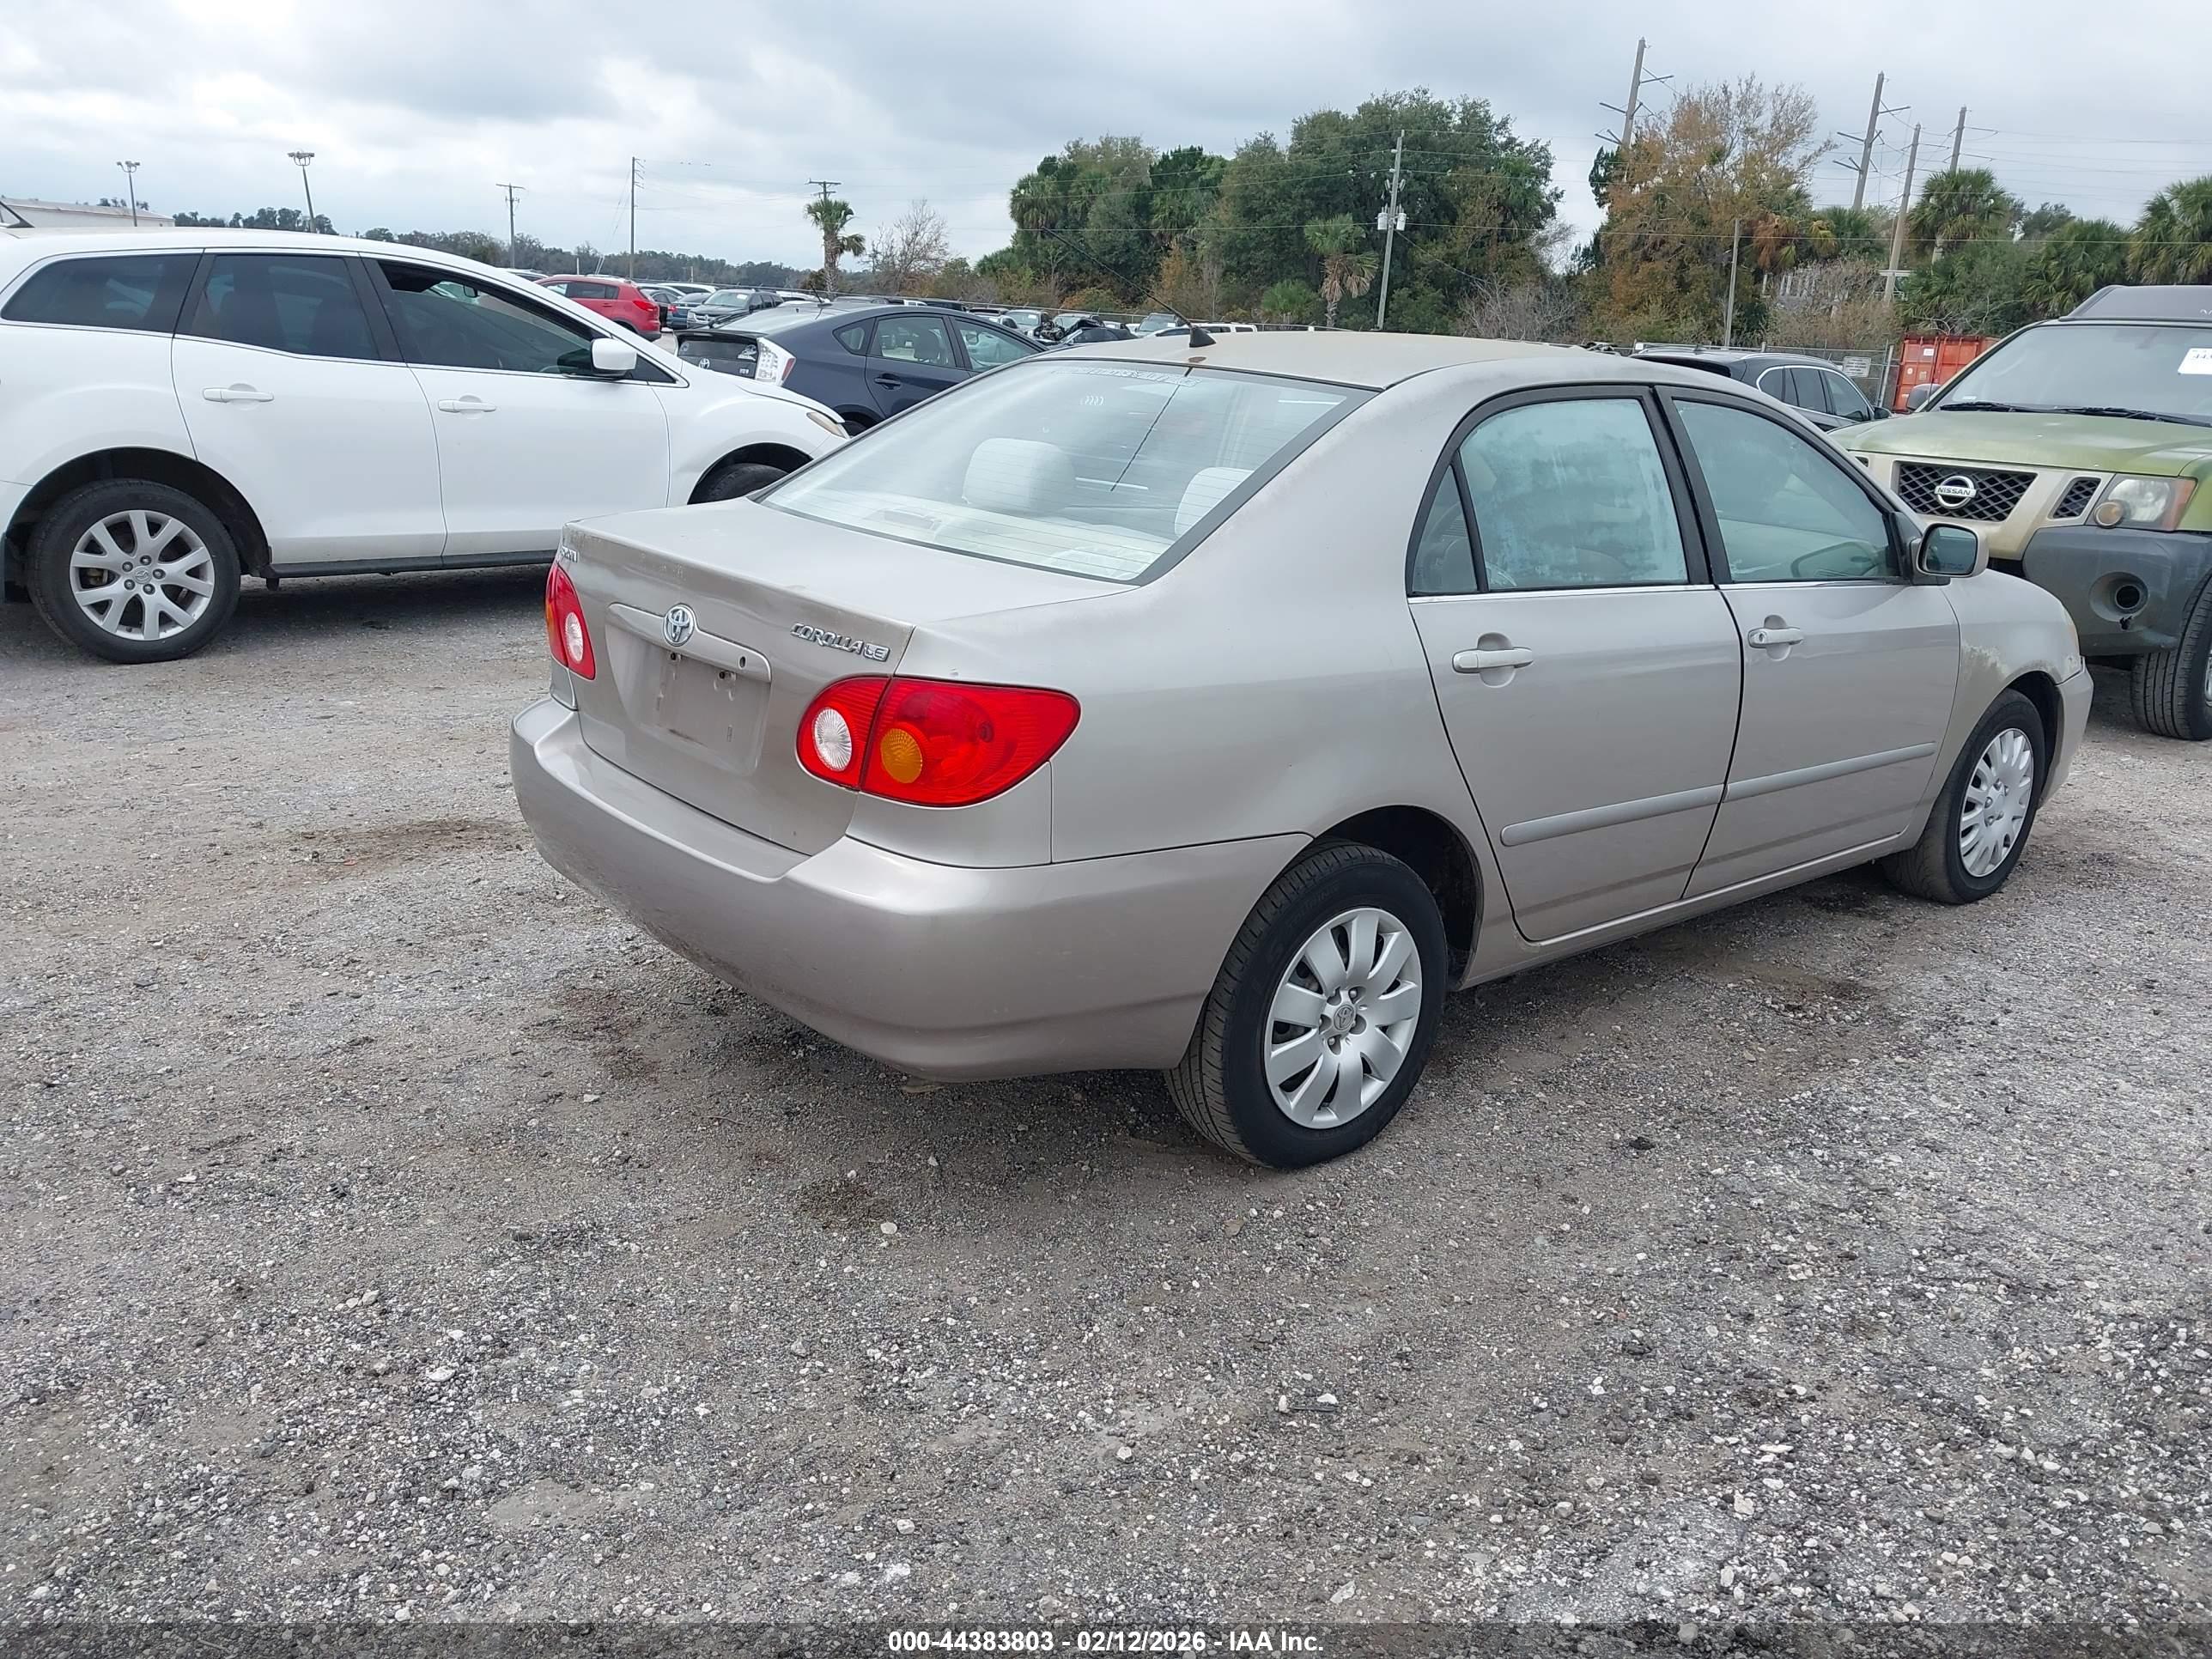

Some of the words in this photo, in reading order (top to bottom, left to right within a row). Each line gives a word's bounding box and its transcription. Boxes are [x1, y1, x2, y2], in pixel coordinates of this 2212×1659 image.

[1937, 487, 1972, 495] NISSAN
[790, 623, 864, 655] COROLLA
[864, 643, 890, 662] LE
